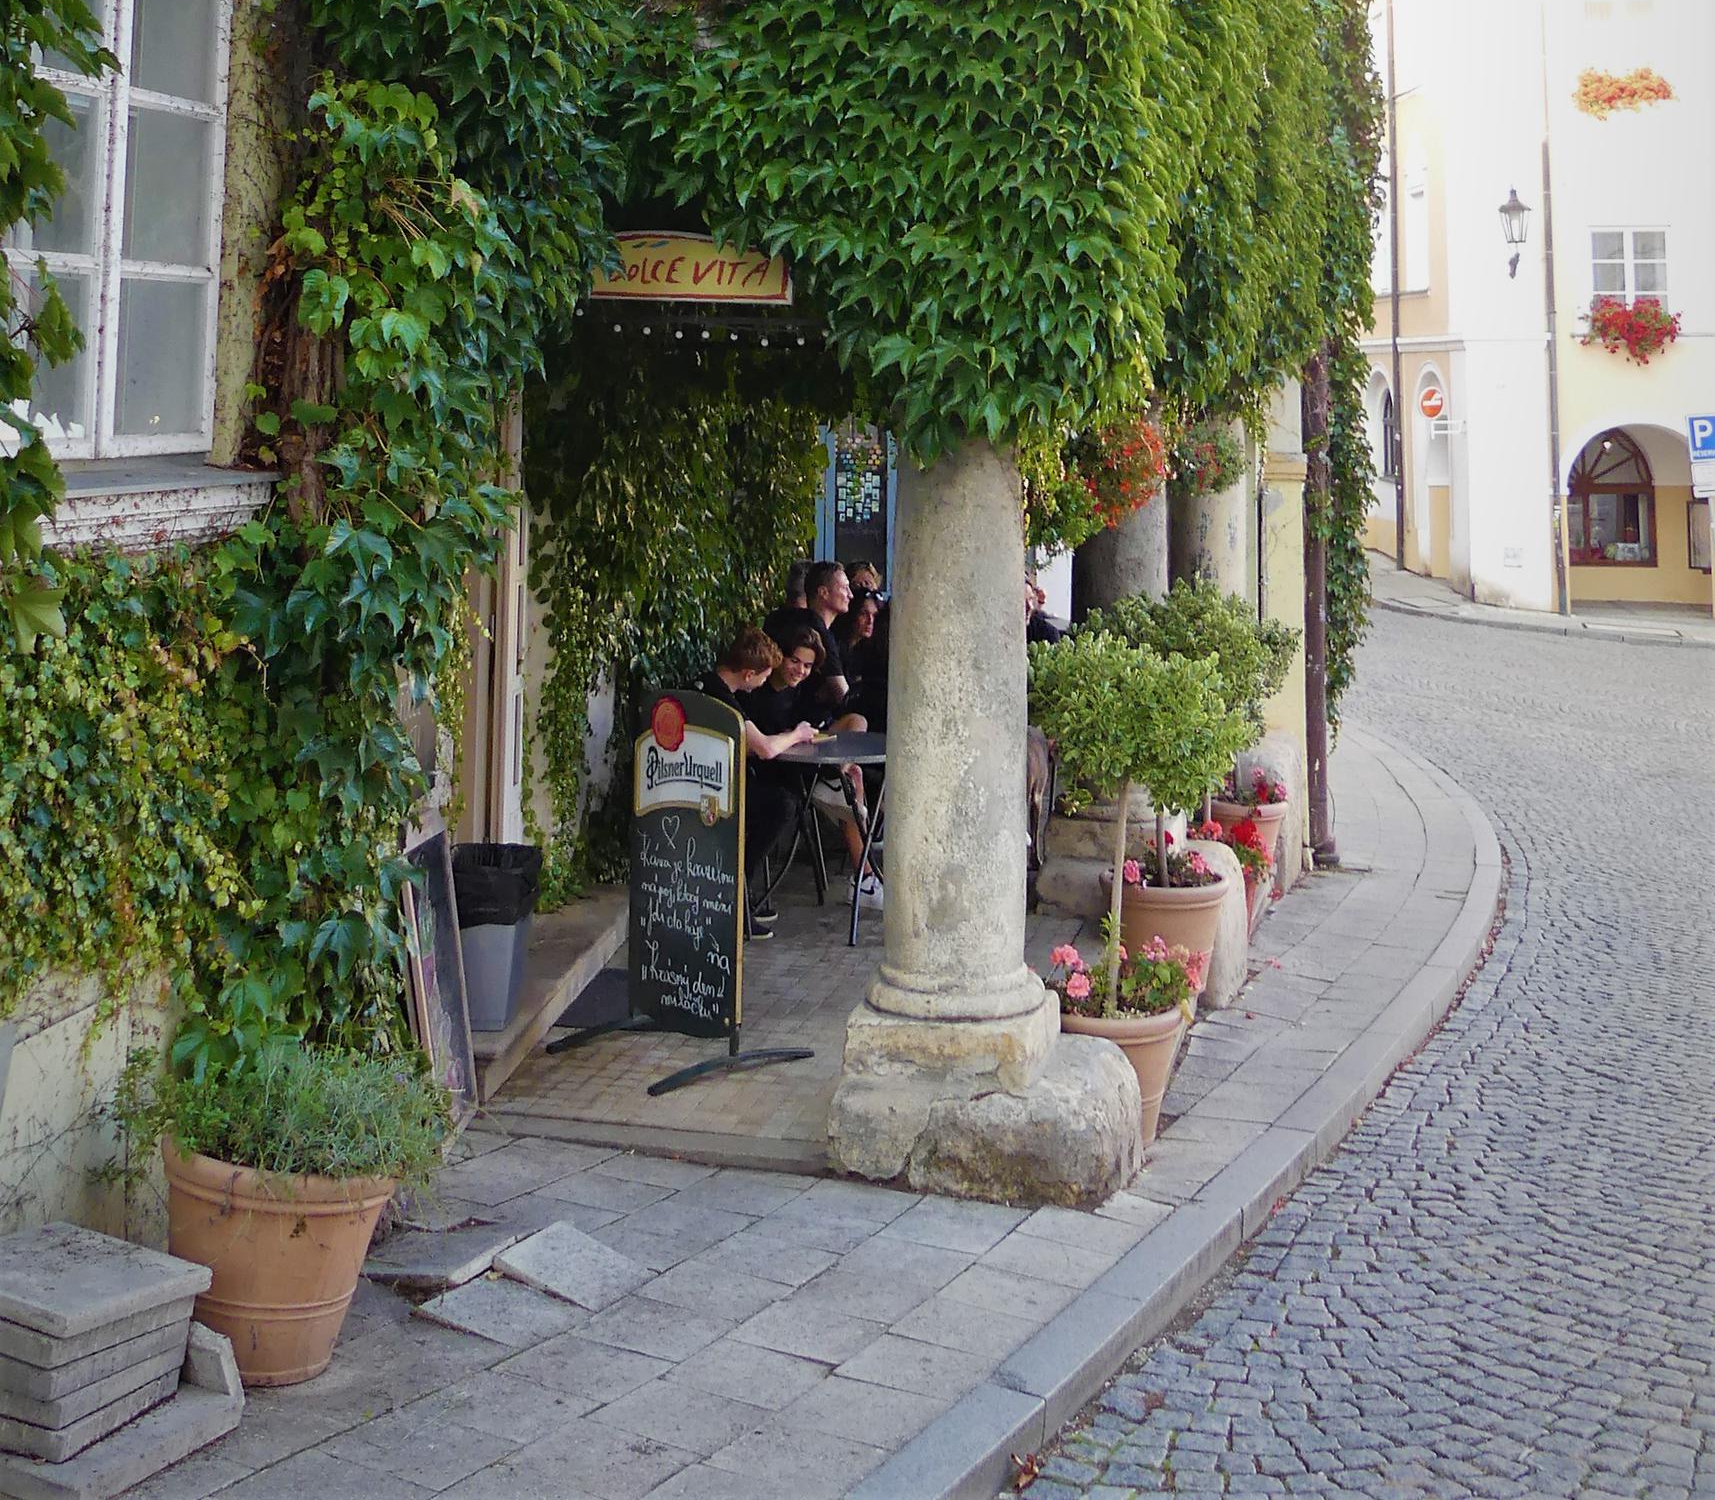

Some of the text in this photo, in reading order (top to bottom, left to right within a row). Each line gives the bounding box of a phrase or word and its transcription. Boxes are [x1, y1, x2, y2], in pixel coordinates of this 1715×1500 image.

[693, 259, 770, 287] VITA
[1693, 419, 1713, 448] P
[646, 746, 722, 790] Pilsner Urquell
